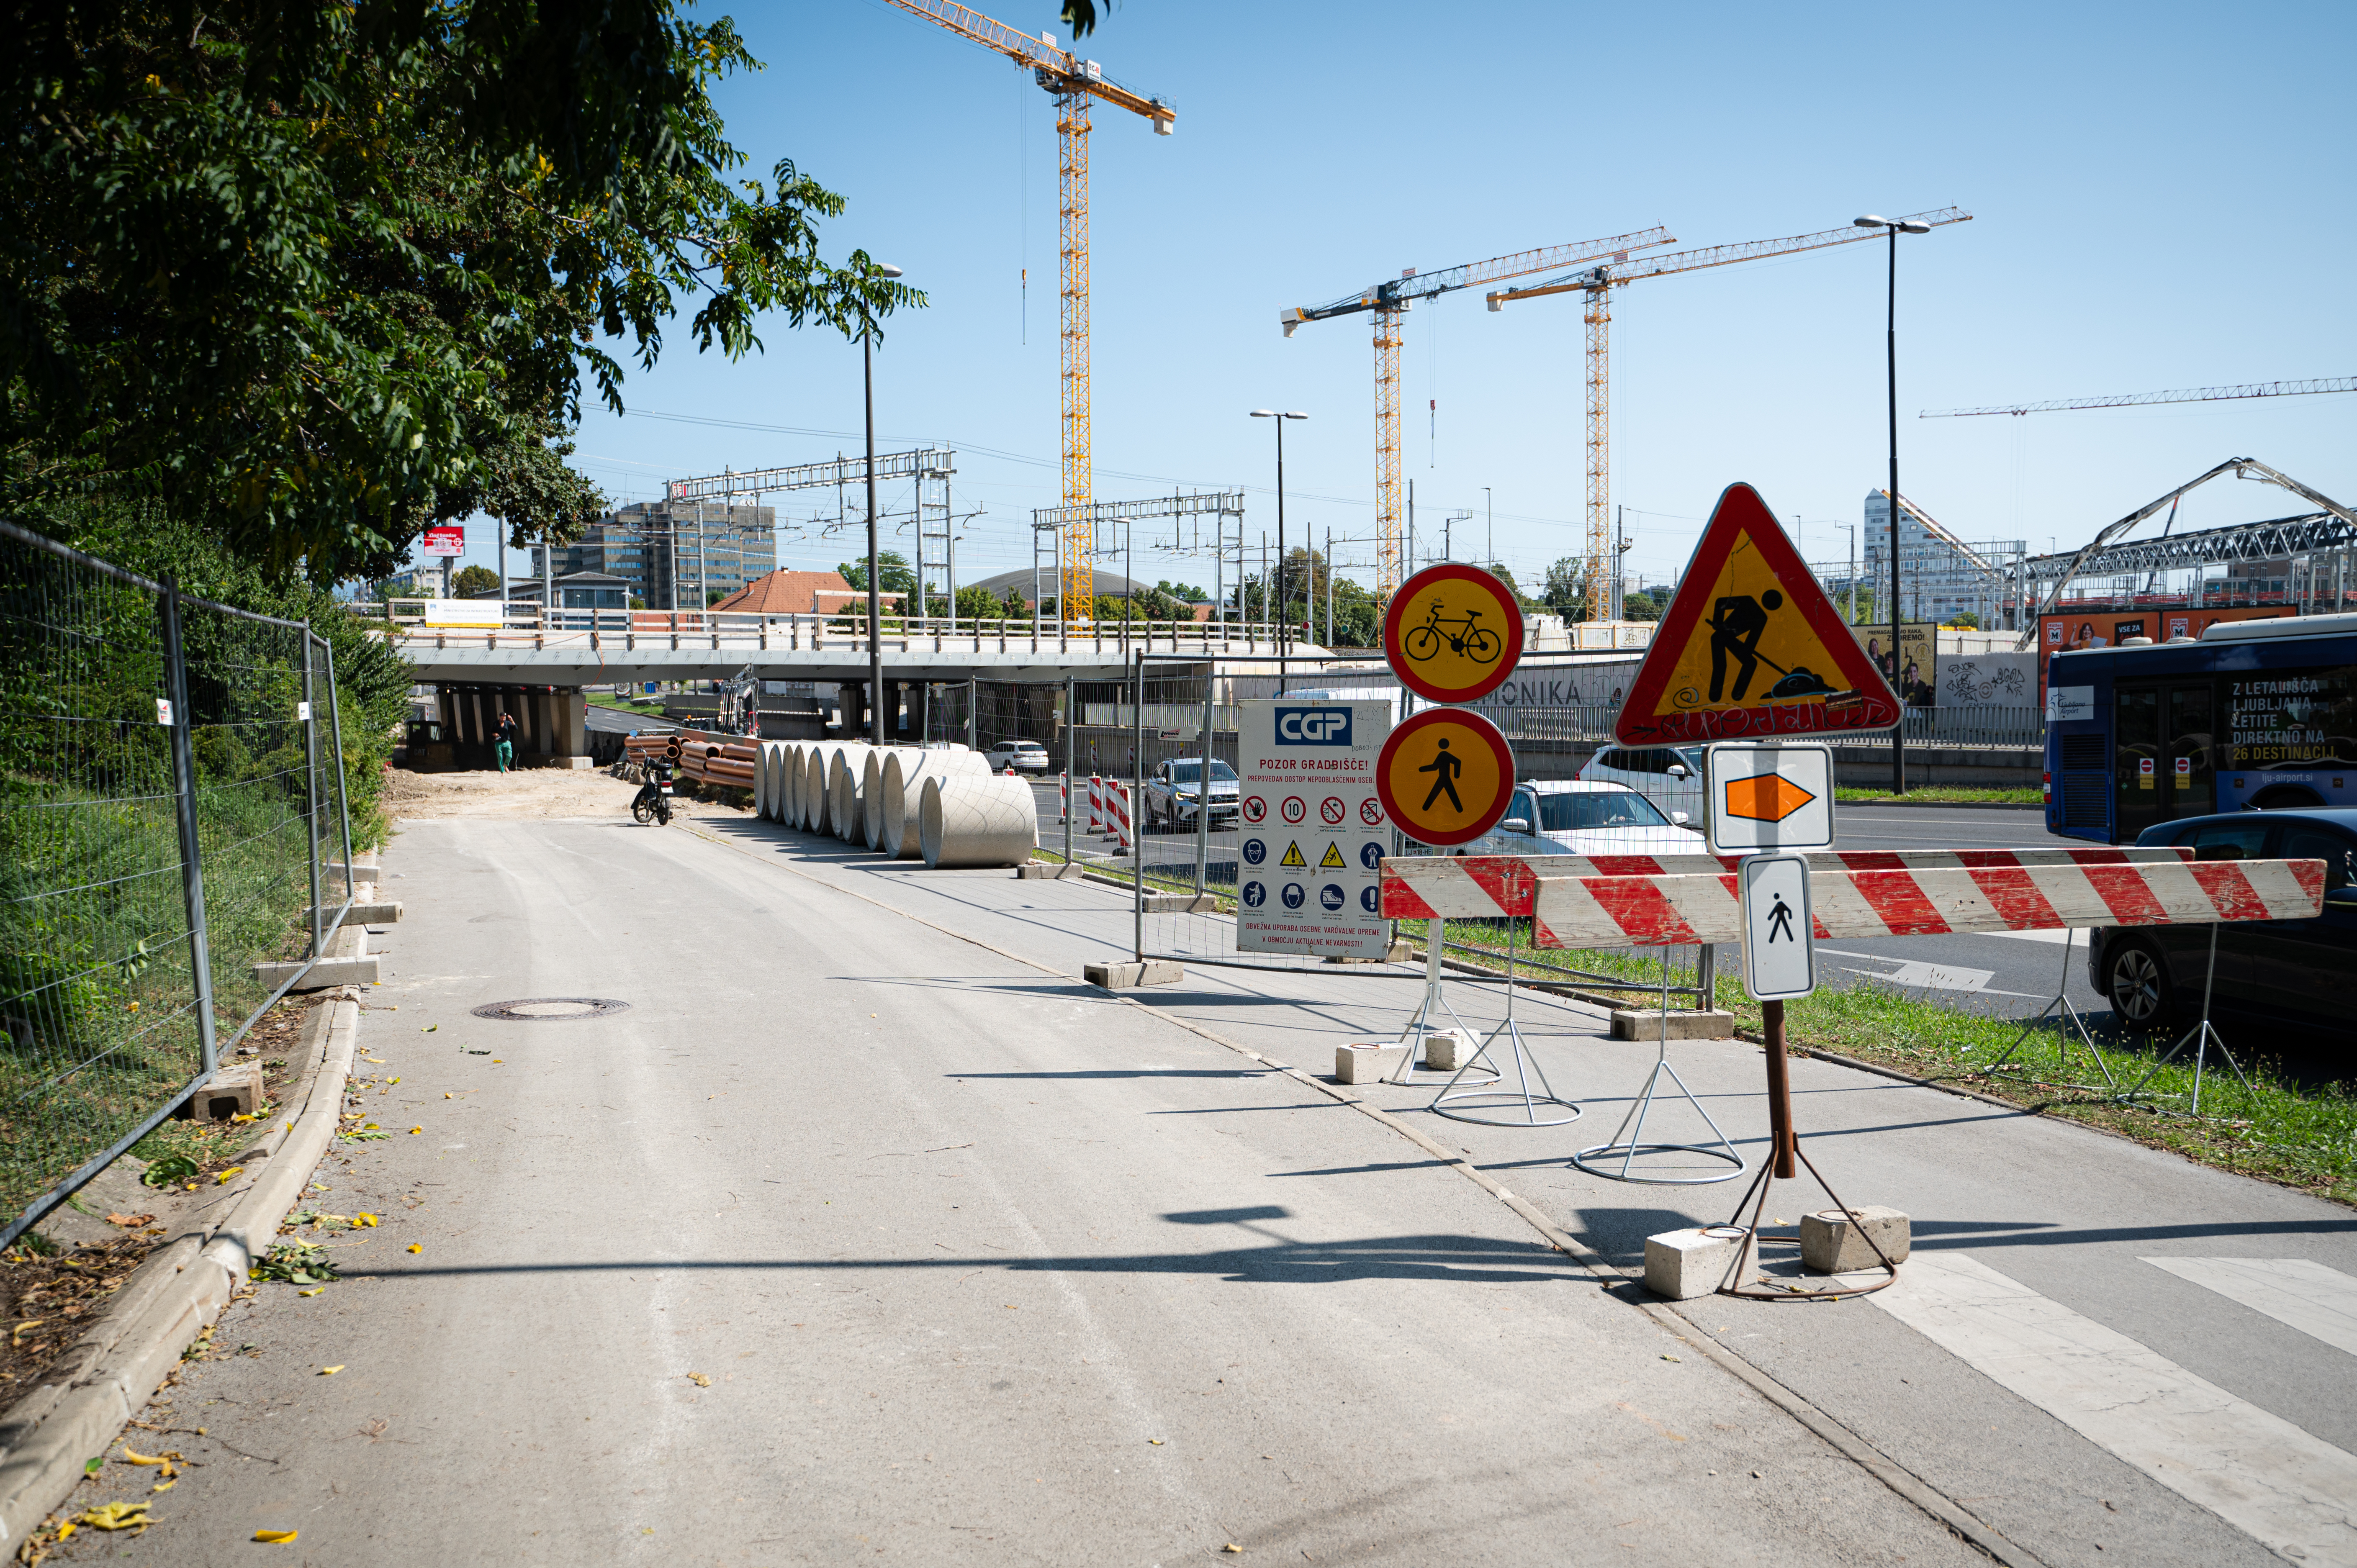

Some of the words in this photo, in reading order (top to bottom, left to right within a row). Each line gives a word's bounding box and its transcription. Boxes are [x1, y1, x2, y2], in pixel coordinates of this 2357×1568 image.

[1089, 63, 1100, 74] EC-B
[2233, 683, 2240, 695] Z
[2246, 677, 2319, 695] LETALIŠČA
[2233, 697, 2311, 711] LJUBLJANA
[1280, 713, 1347, 740] CGP
[2233, 714, 2277, 728] LETITE
[2233, 731, 2300, 744] DIREKTNO
[2306, 730, 2325, 743] NA
[2233, 747, 2249, 760] 26
[2253, 746, 2339, 760] DESTINACIJ.
[1259, 759, 1296, 770] POZOR
[1301, 758, 1368, 770] GRADBIŠČE!
[2262, 773, 2313, 783] lju-airport.si
[1288, 803, 1299, 816] 10
[1268, 935, 1294, 944] OBMOČJU
[1325, 939, 1363, 947] NEVARNOSTI!
